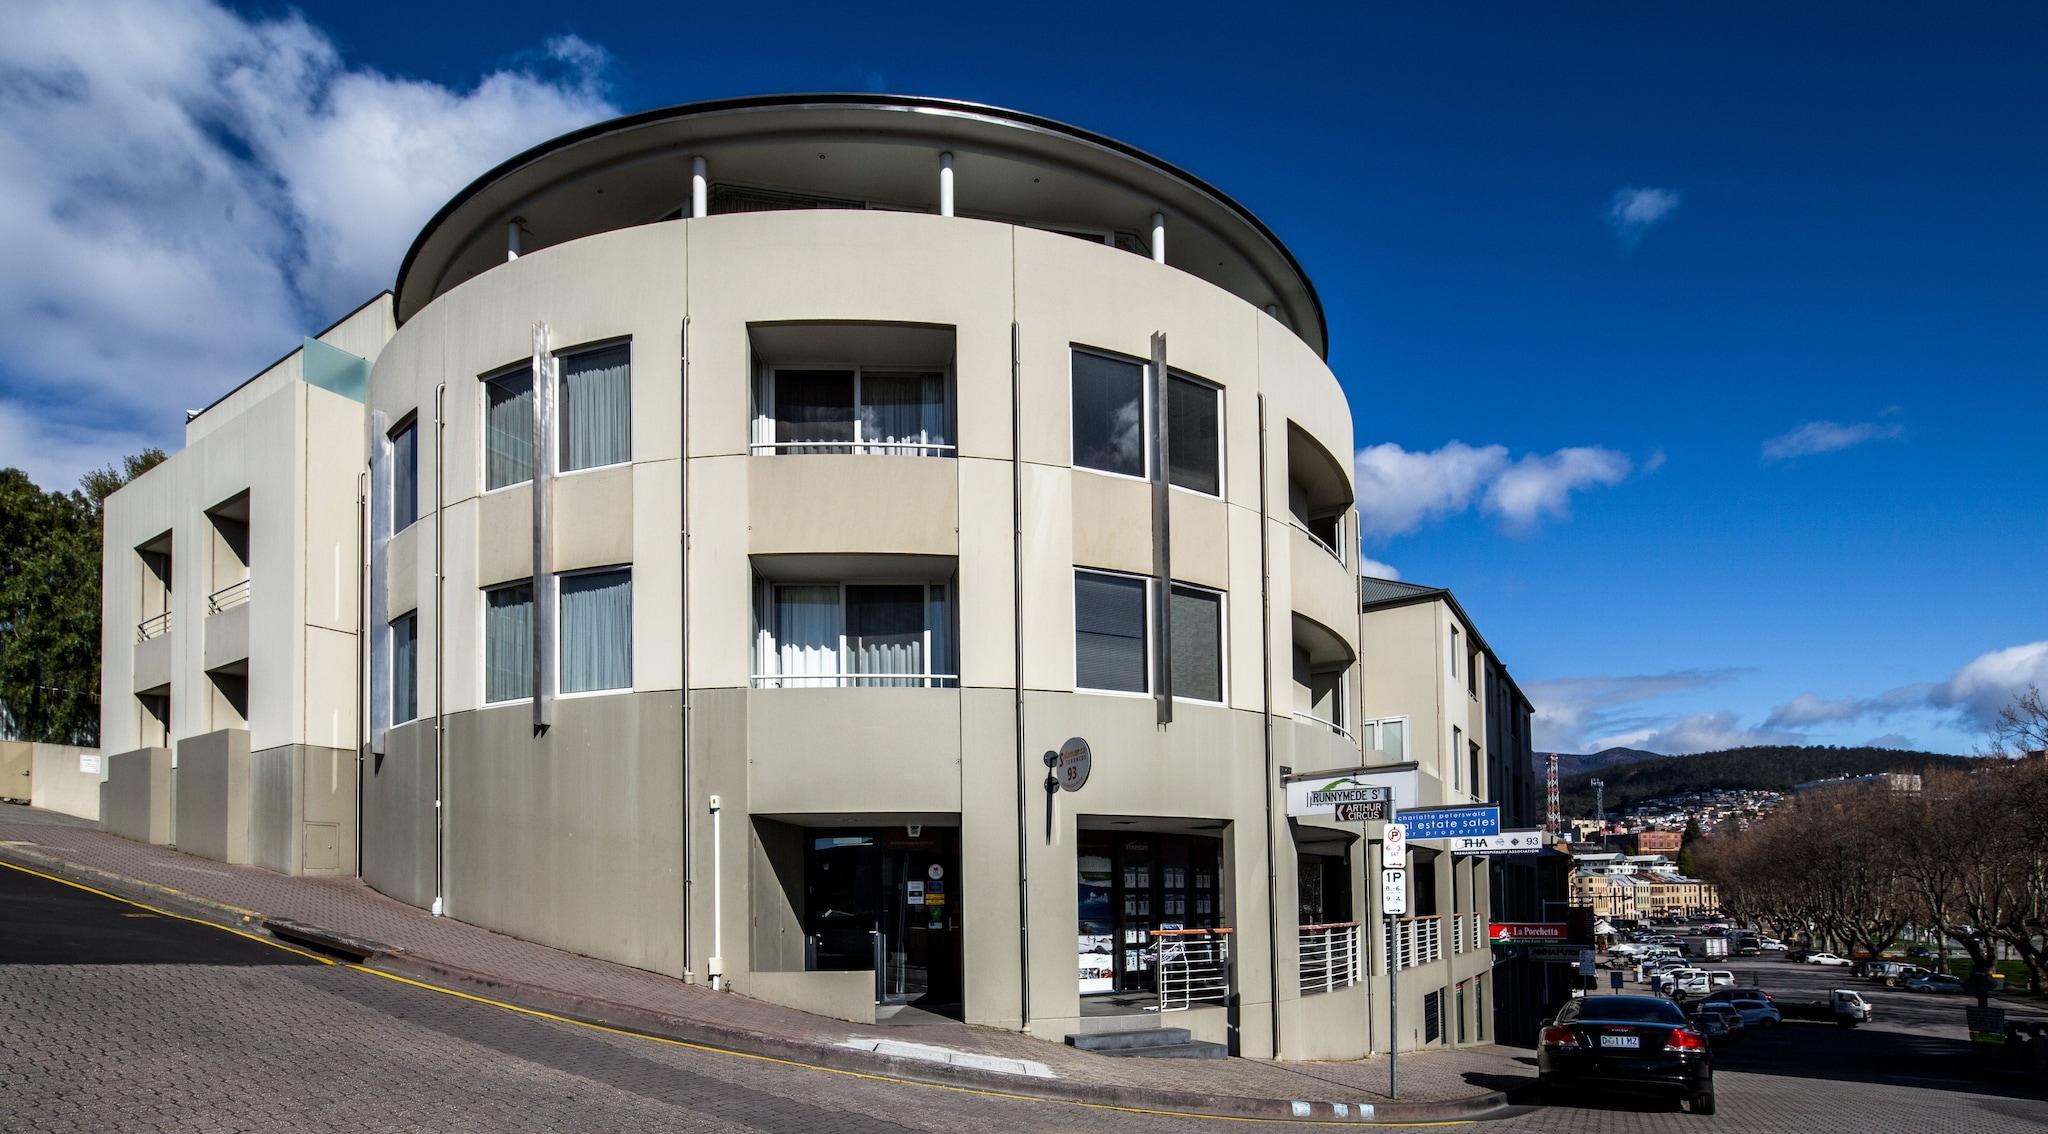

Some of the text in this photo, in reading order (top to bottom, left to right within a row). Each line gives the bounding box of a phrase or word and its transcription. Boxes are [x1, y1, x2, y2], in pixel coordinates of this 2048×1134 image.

[1067, 765, 1077, 781] 93
[1313, 790, 1368, 803] RUNNYMEDE
[1346, 803, 1382, 812] ARTHUR
[1348, 811, 1380, 820] CIRCUS
[1397, 811, 1486, 822] charlotte peterswald
[1417, 820, 1458, 830] estate
[1462, 818, 1496, 828] sales
[1425, 828, 1487, 836] property
[1525, 837, 1539, 846] 93
[1386, 872, 1402, 883] 1P
[1513, 927, 1558, 936] La Porchetta
